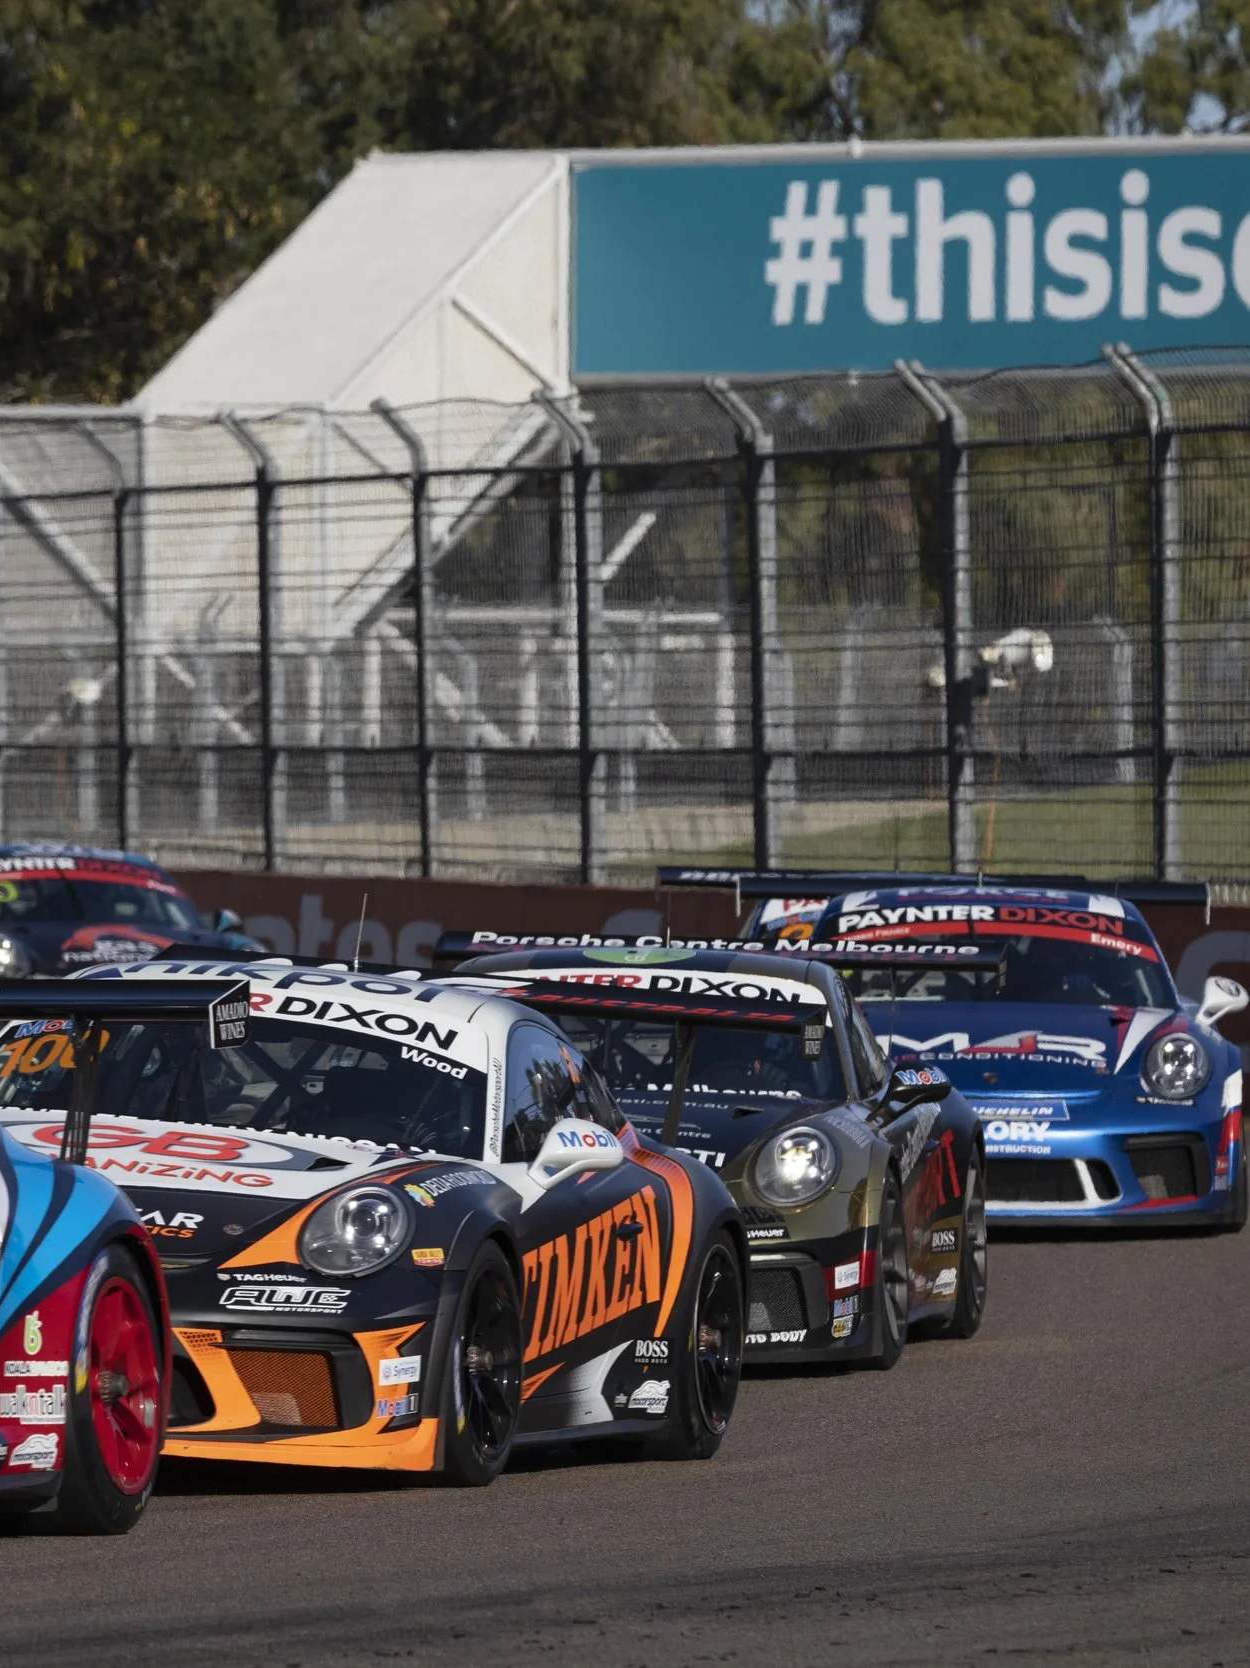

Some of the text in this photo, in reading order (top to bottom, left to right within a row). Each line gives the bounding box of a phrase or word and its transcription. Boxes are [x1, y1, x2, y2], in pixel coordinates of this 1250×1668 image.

[764, 167, 1250, 327] #thisis
[838, 904, 995, 934] PAYNTER
[999, 905, 1124, 936] DIXON
[471, 930, 626, 949] Porsche
[635, 935, 765, 951] Centre
[774, 938, 980, 956] Melbourne
[1090, 932, 1143, 956] Emery
[215, 1001, 249, 1021] AMADIO
[218, 1021, 246, 1042] WINES
[276, 996, 459, 1051] DIXON
[400, 1045, 468, 1080] Wood
[917, 1051, 1108, 1068] CONDITIONING
[32, 1122, 249, 1162] GB
[557, 1130, 618, 1148] Mobil
[985, 1144, 1051, 1155] NSTRUCTION
[931, 1230, 956, 1248] BOSS
[274, 1306, 344, 1314] MOTORSPORT
[635, 1339, 669, 1358] BOSS
